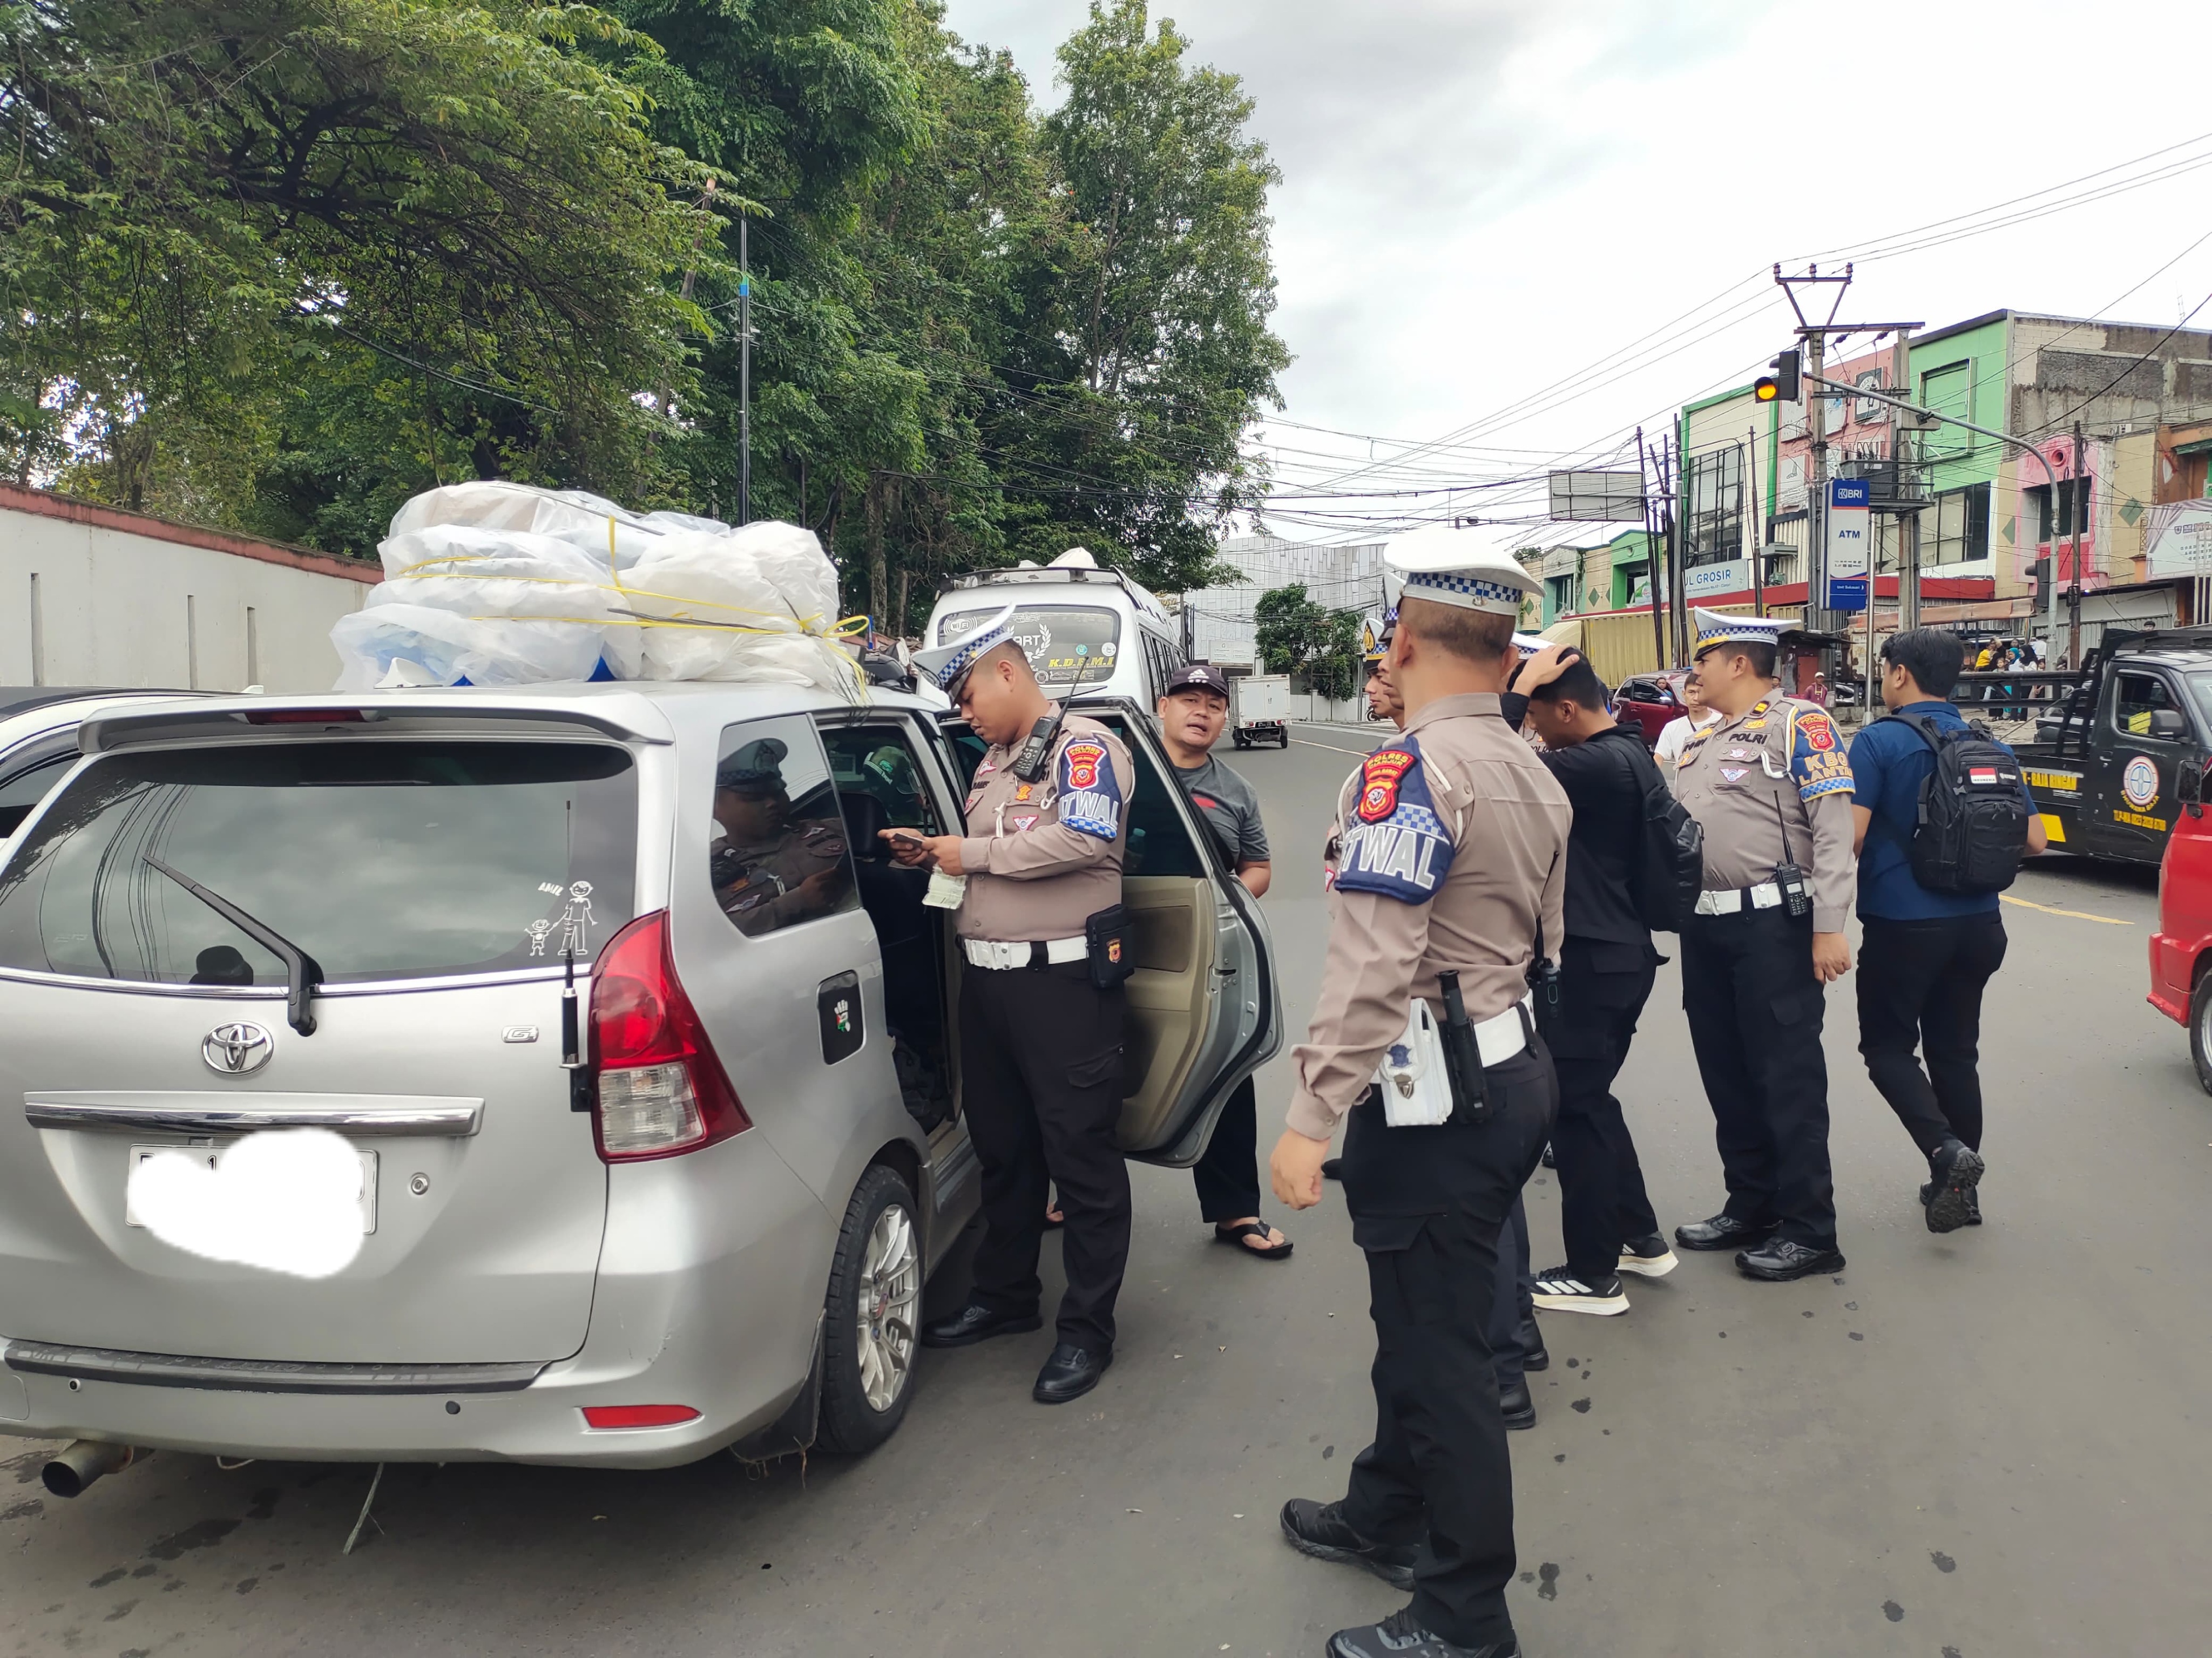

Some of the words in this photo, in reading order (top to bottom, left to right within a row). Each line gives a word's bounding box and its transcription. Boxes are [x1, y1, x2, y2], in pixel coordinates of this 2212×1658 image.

[1848, 489, 1862, 498] BRI
[1839, 530, 1861, 538] ATM
[1696, 569, 1731, 584] GROSIR
[1729, 733, 1768, 745] POLRI
[1368, 753, 1409, 766] POLRES
[1804, 752, 1848, 772] KBO
[506, 1027, 533, 1040] G
